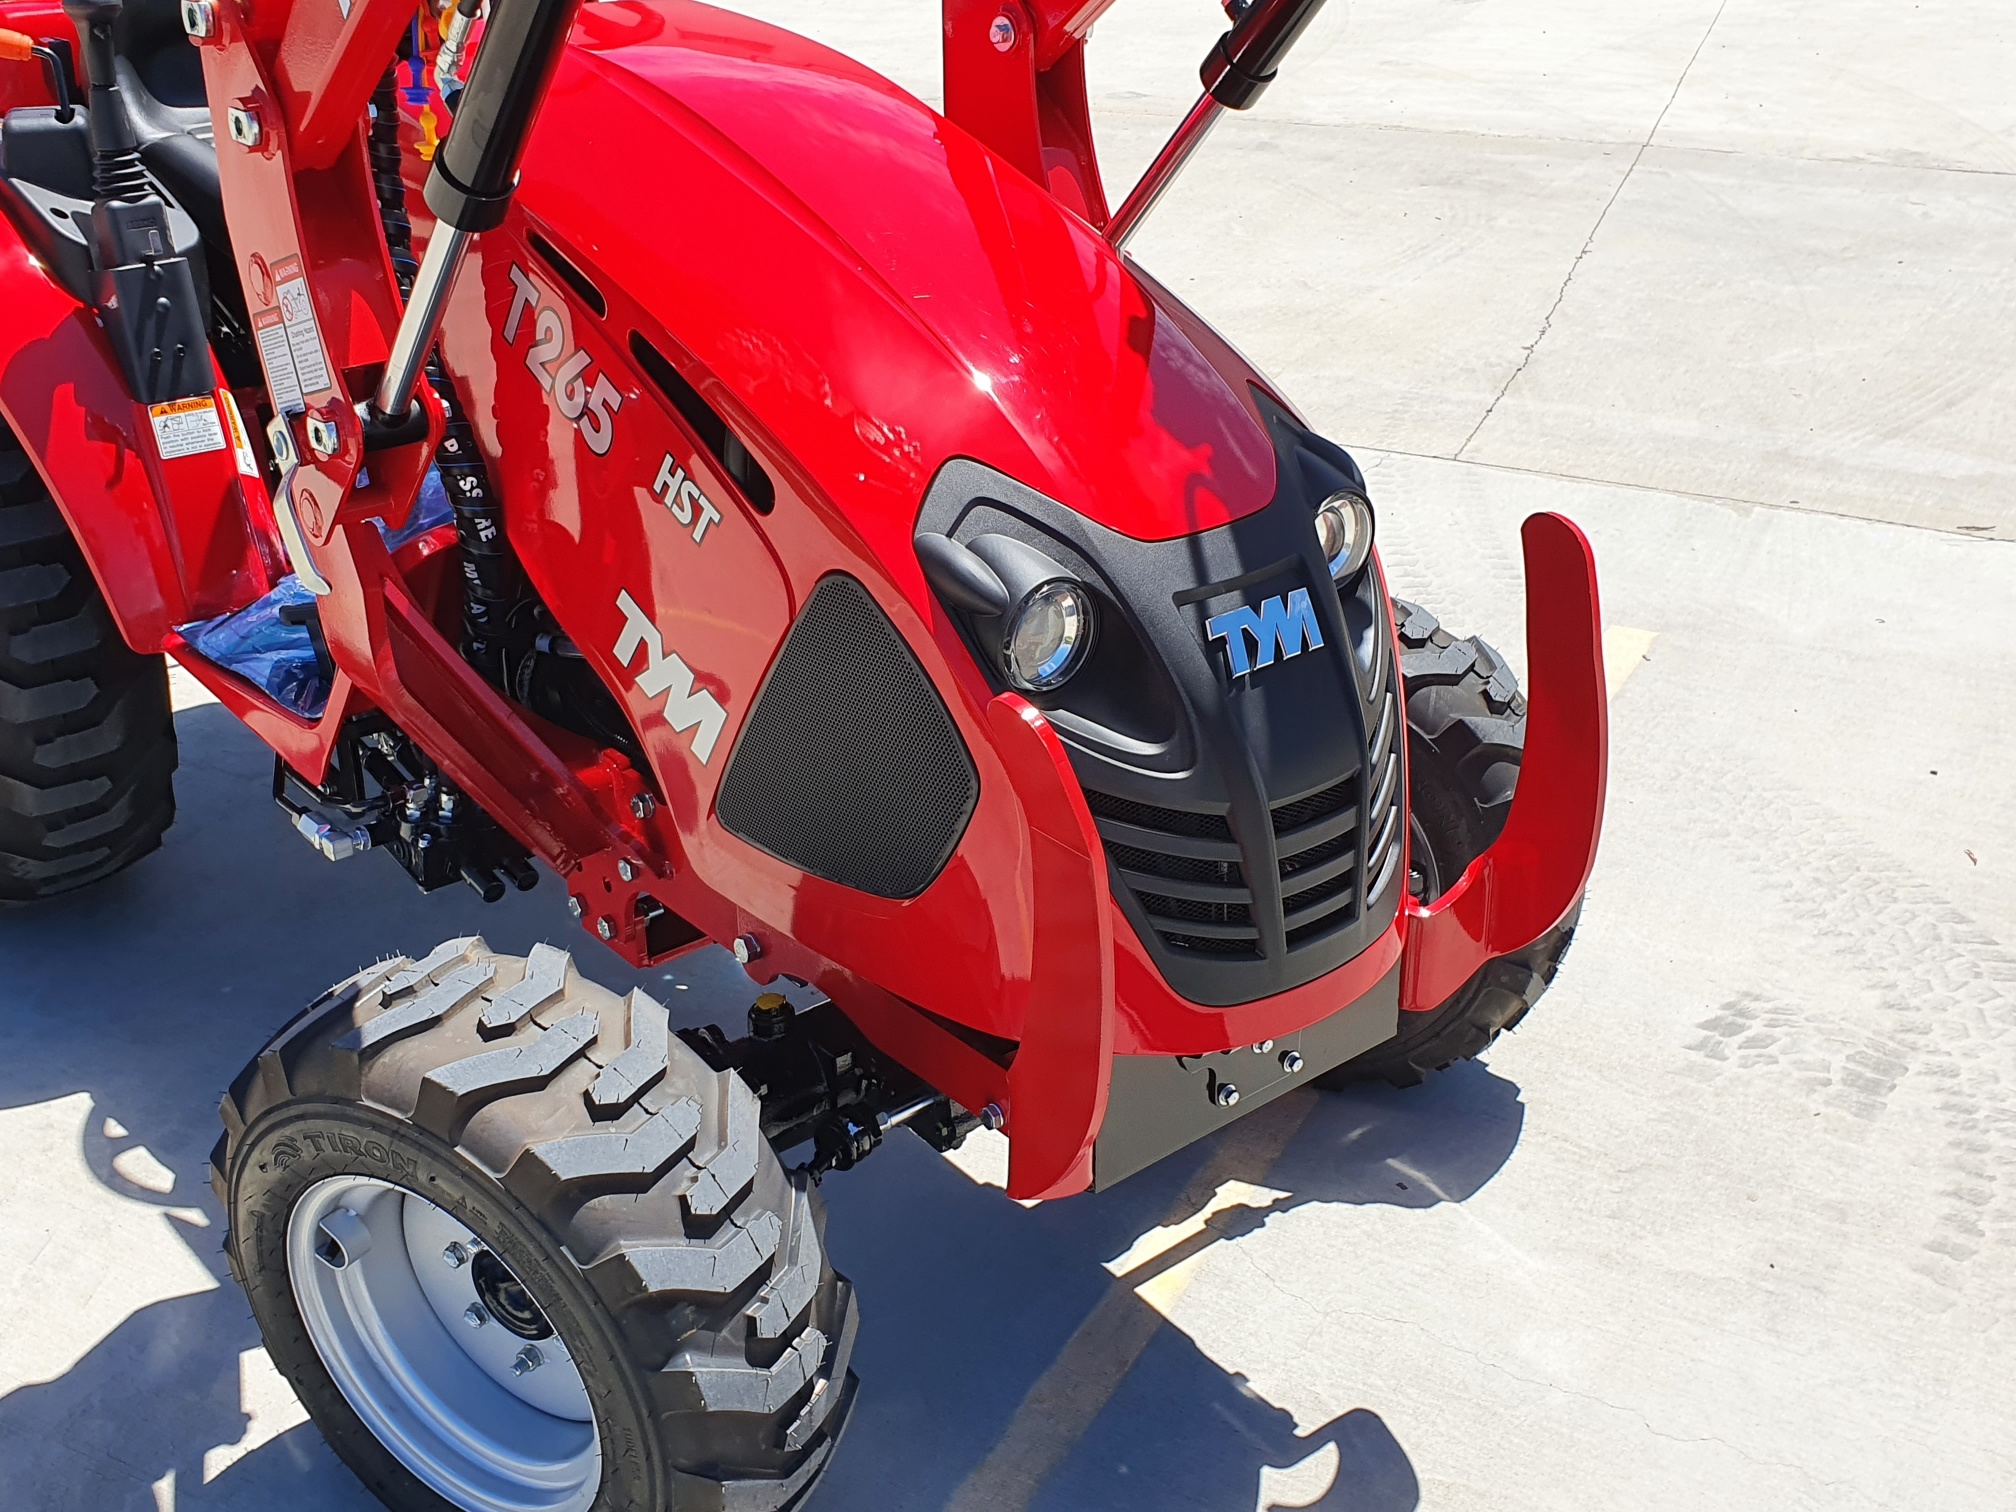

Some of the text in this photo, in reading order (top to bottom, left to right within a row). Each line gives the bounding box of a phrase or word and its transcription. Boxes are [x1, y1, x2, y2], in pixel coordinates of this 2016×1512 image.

[502, 259, 625, 458] T265
[169, 400, 207, 412] WARNING
[651, 450, 723, 547] HST
[612, 585, 729, 767] TYM
[1205, 587, 1324, 679] TYM
[303, 1131, 418, 1180] TIRON
